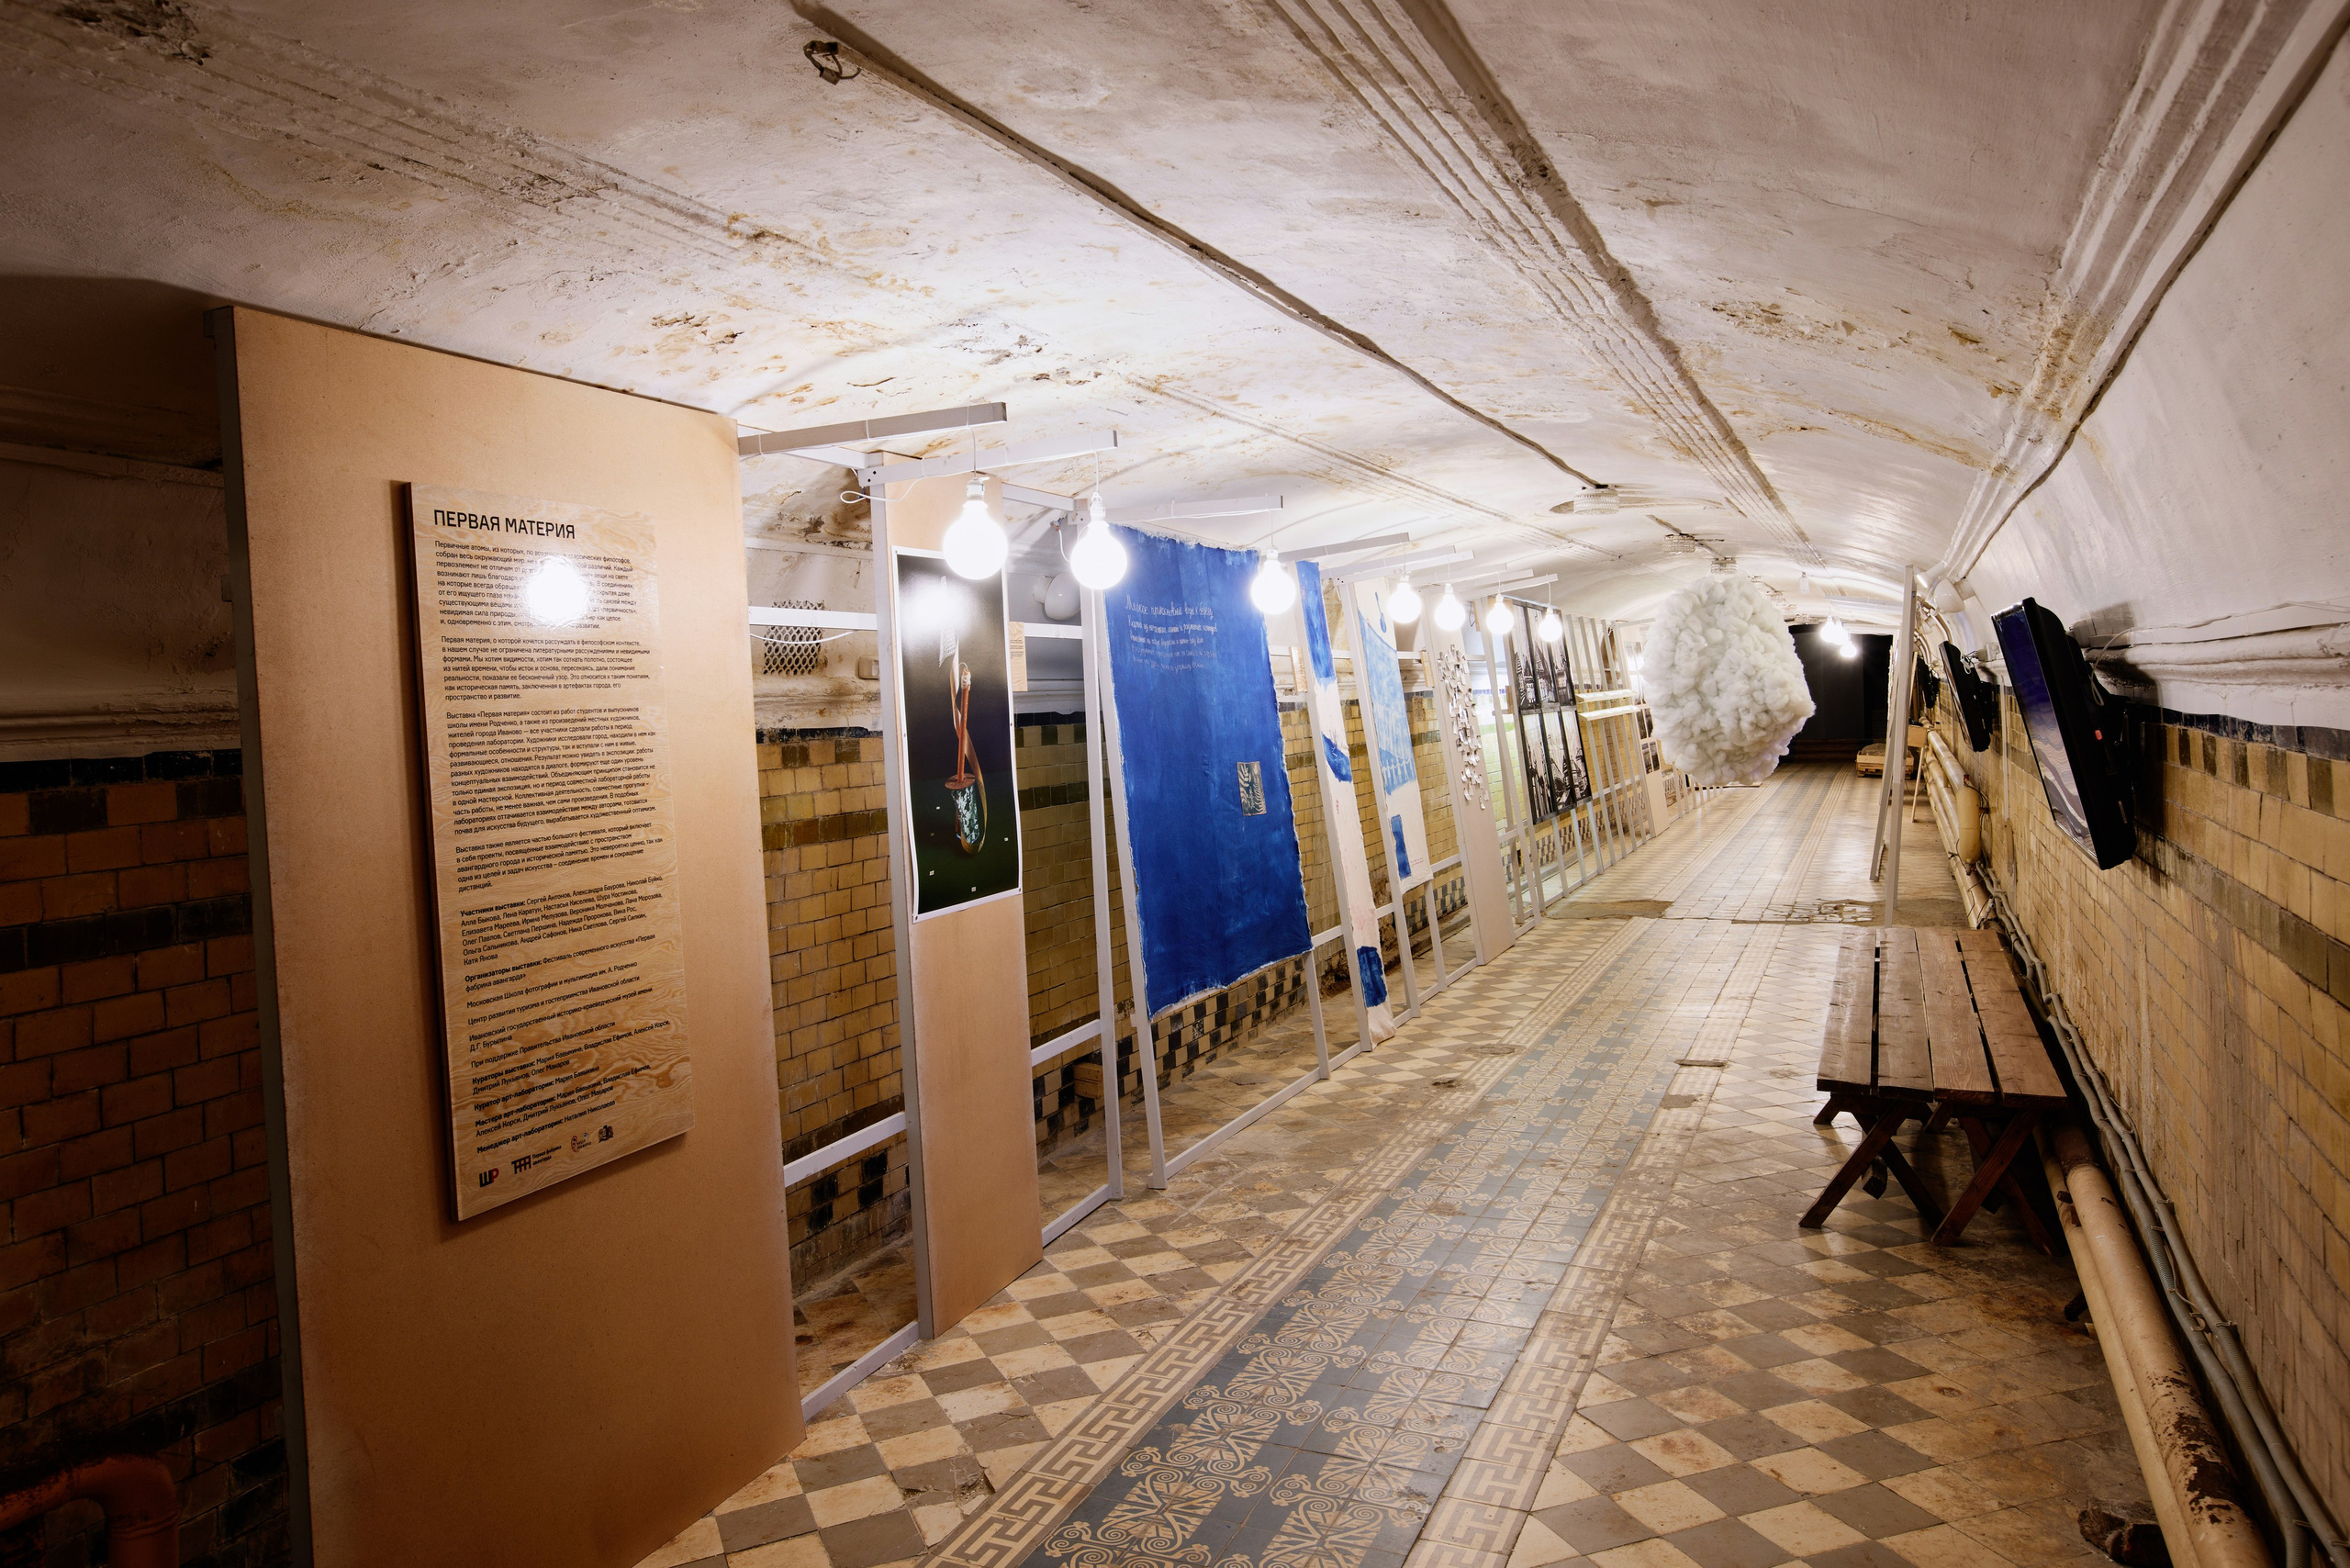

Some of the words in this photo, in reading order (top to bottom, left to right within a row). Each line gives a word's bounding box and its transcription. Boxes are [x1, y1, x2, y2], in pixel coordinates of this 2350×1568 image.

[433, 510, 500, 531] ПЕРВАЯ
[504, 517, 575, 538] МАТЕРИЯ
[441, 635, 464, 644] Первая
[455, 844, 485, 853] Выставка
[504, 838, 530, 846] является
[551, 832, 578, 840] большого
[578, 828, 607, 838] фестиваля,
[607, 824, 629, 832] который
[460, 906, 494, 917] Участники
[494, 900, 525, 911] выставки:
[526, 895, 547, 905] Сергей
[572, 886, 603, 896] Александра
[626, 877, 647, 887] Николай
[460, 919, 476, 927] Алла
[543, 901, 568, 911] Настасья
[461, 925, 493, 936] Елизавета
[521, 916, 540, 925] Ирина
[569, 905, 595, 915] Вероника
[462, 938, 478, 946] Олег
[502, 927, 530, 938] Светлана
[558, 917, 583, 926] Надежда
[462, 947, 481, 956] Ольга
[519, 933, 541, 944] Андрей
[608, 915, 626, 925] Сергей
[463, 957, 478, 965] Катя
[479, 953, 498, 962] Янова
[464, 966, 510, 983] Организаторы
[511, 959, 542, 971] выставки:
[542, 952, 572, 964] Фестиваль
[572, 944, 609, 957] современного
[610, 938, 634, 948] искусства
[635, 933, 655, 942] «Первая
[465, 980, 491, 993] фабрика
[492, 973, 526, 985] авангарда»
[466, 994, 503, 1008] Московская
[504, 989, 523, 999] Школа
[524, 981, 558, 995] фотографии
[563, 971, 598, 984] мультимедиа
[613, 961, 637, 971] Родченко
[467, 1015, 487, 1026] Центр
[488, 1007, 515, 1021] развития
[516, 1001, 539, 1013] туризма
[545, 989, 588, 1005] гостеприимства
[588, 979, 619, 993] Ивановской
[620, 975, 640, 985] области
[469, 1025, 506, 1042] Ивановский
[506, 1011, 556, 1031] государственный
[622, 990, 637, 1000] музей
[637, 987, 652, 995] имени
[471, 1059, 484, 1068] При
[484, 1049, 518, 1064] поддержке
[519, 1036, 561, 1054] Правительства
[561, 1025, 594, 1041] Ивановской
[594, 1020, 615, 1031] области
[472, 1070, 504, 1085] Кураторы
[504, 1060, 535, 1075] выставки:
[536, 1054, 554, 1065] Мария
[583, 1037, 612, 1050] Владислав
[633, 1023, 654, 1035] Алексей
[482, 1034, 513, 1048] Бурылина
[472, 1079, 500, 1095] Дмитрий
[531, 1066, 545, 1076] Олег
[545, 1059, 570, 1071] Макаров
[474, 1097, 501, 1111] Куратор
[500, 1080, 554, 1102] арт-лаборатории:
[554, 1074, 573, 1084] Мария
[573, 1065, 600, 1078] Бавыкина
[474, 1113, 503, 1127] Мастера
[502, 1095, 555, 1118] арт-лаборатории:
[556, 1089, 574, 1100] Мария
[602, 1070, 630, 1084] Владислав
[475, 1122, 501, 1137] Алексей
[522, 1105, 549, 1122] Дмитрий
[576, 1093, 590, 1102] Олег
[590, 1084, 614, 1097] Макаров
[476, 1137, 511, 1154] Менеджер
[510, 1118, 563, 1142] арт-лаборатории:
[563, 1109, 586, 1122] Наталия
[587, 1099, 616, 1114] Николаева
[479, 1168, 499, 1187] ШР
